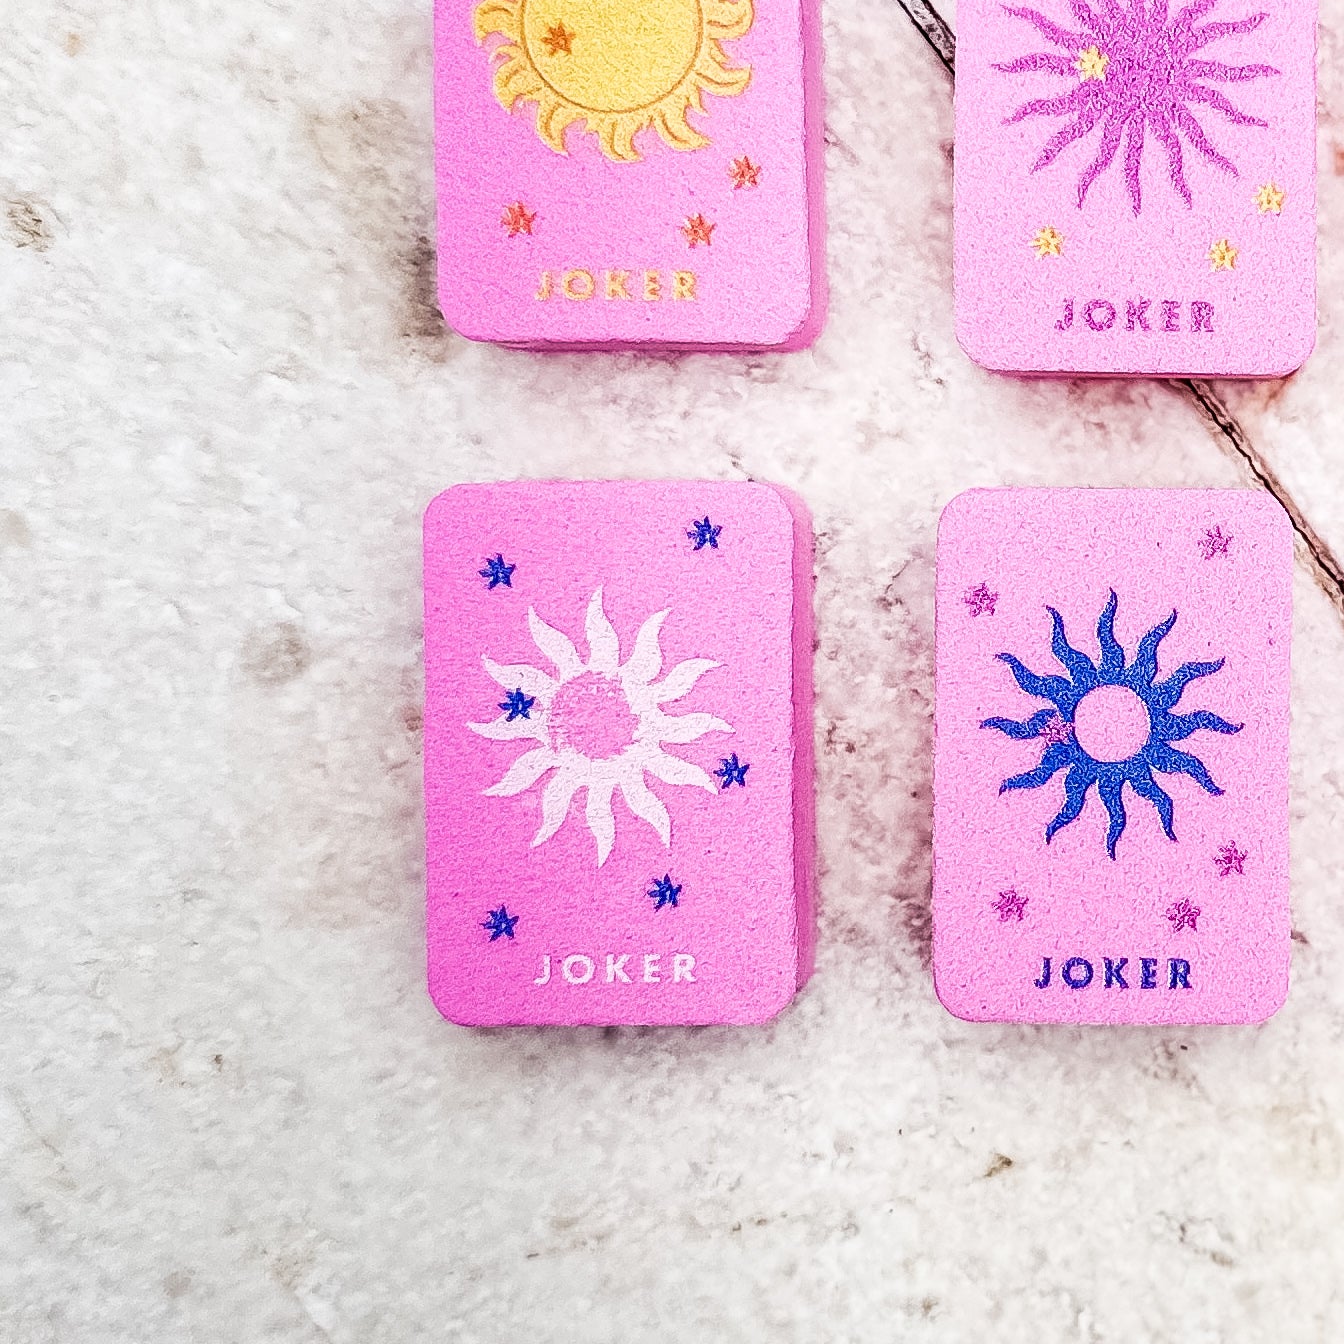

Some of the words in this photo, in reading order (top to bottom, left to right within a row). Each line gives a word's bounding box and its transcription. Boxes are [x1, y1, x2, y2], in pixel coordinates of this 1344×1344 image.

[536, 269, 698, 302] JOKER
[1055, 298, 1215, 333] JOKER
[535, 952, 698, 985] JOKER
[1034, 956, 1193, 990] JOKER
